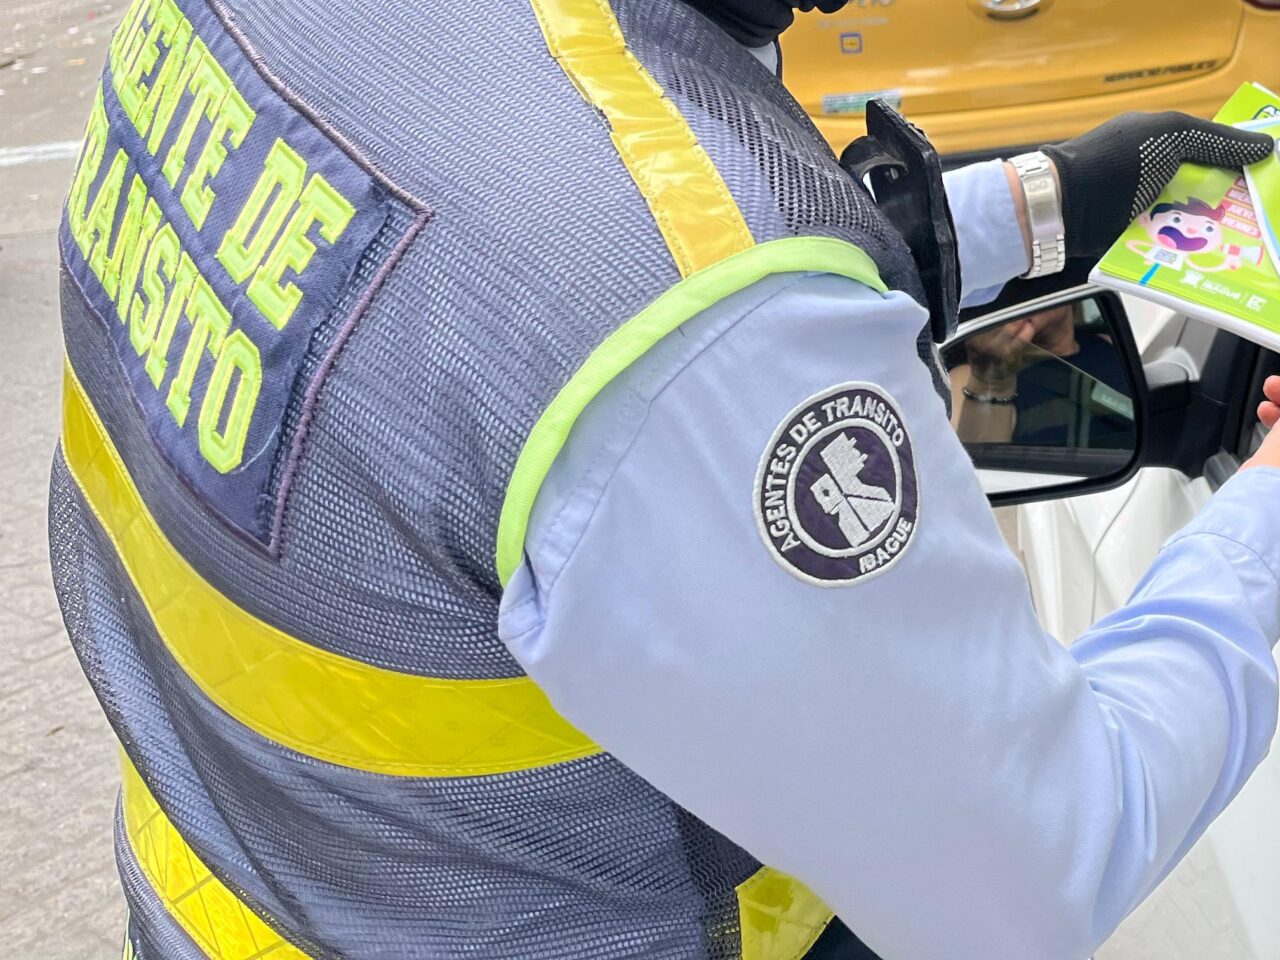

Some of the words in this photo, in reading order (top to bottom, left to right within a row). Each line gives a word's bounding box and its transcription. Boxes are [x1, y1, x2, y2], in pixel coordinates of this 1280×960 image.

[215, 137, 357, 330] DE
[764, 444, 801, 552] AGENTES
[789, 411, 823, 446] DE
[821, 395, 905, 448] TRANSITO
